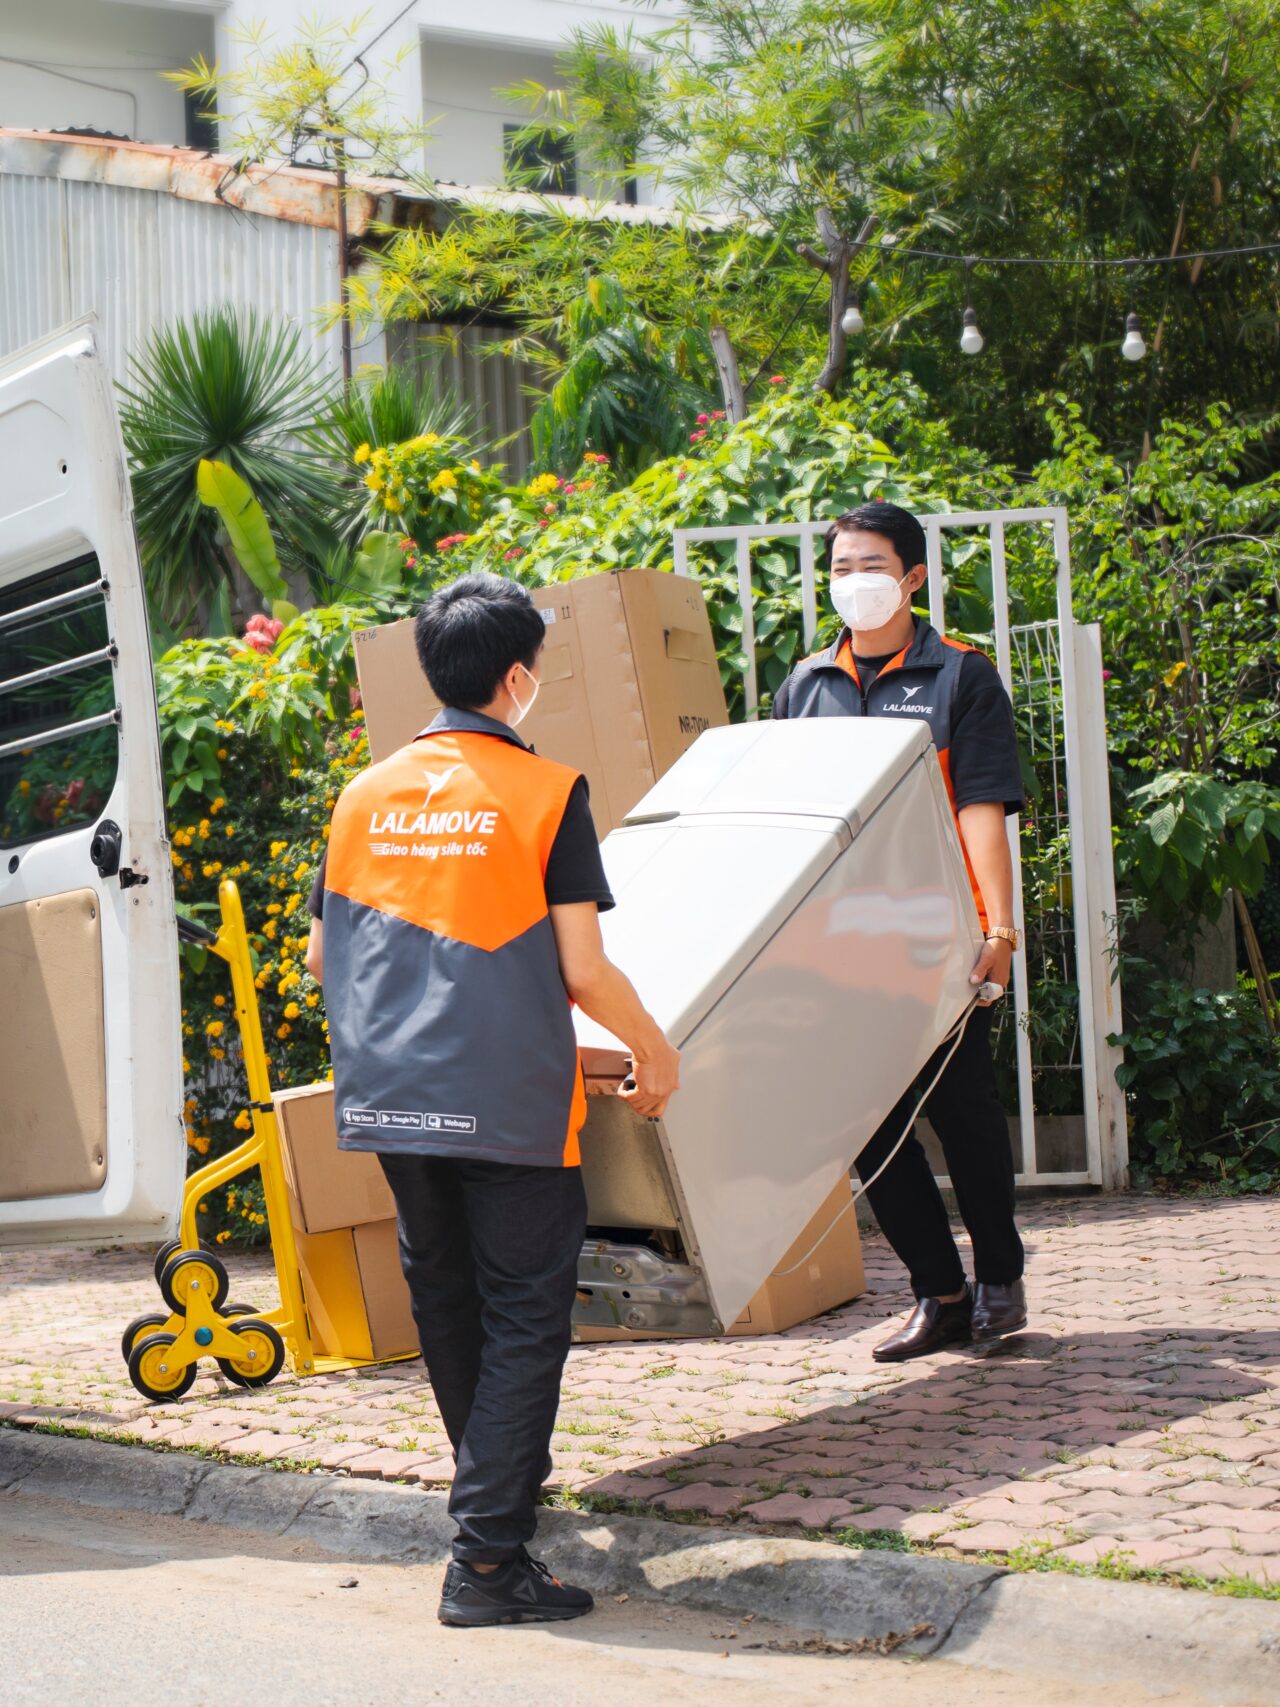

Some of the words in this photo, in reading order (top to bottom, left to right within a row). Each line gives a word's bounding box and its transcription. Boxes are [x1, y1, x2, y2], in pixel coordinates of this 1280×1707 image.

[882, 703, 933, 714] LALAMOVE
[369, 811, 499, 834] LALAMOVE
[382, 843, 408, 856] Giao
[411, 843, 440, 859] hàng
[441, 842, 463, 856] siêu
[466, 841, 488, 856] tốc
[352, 1113, 361, 1122] App
[361, 1114, 374, 1122] Store
[392, 1115, 409, 1124] Google
[409, 1116, 420, 1125] Play
[444, 1119, 471, 1128] Webapp
